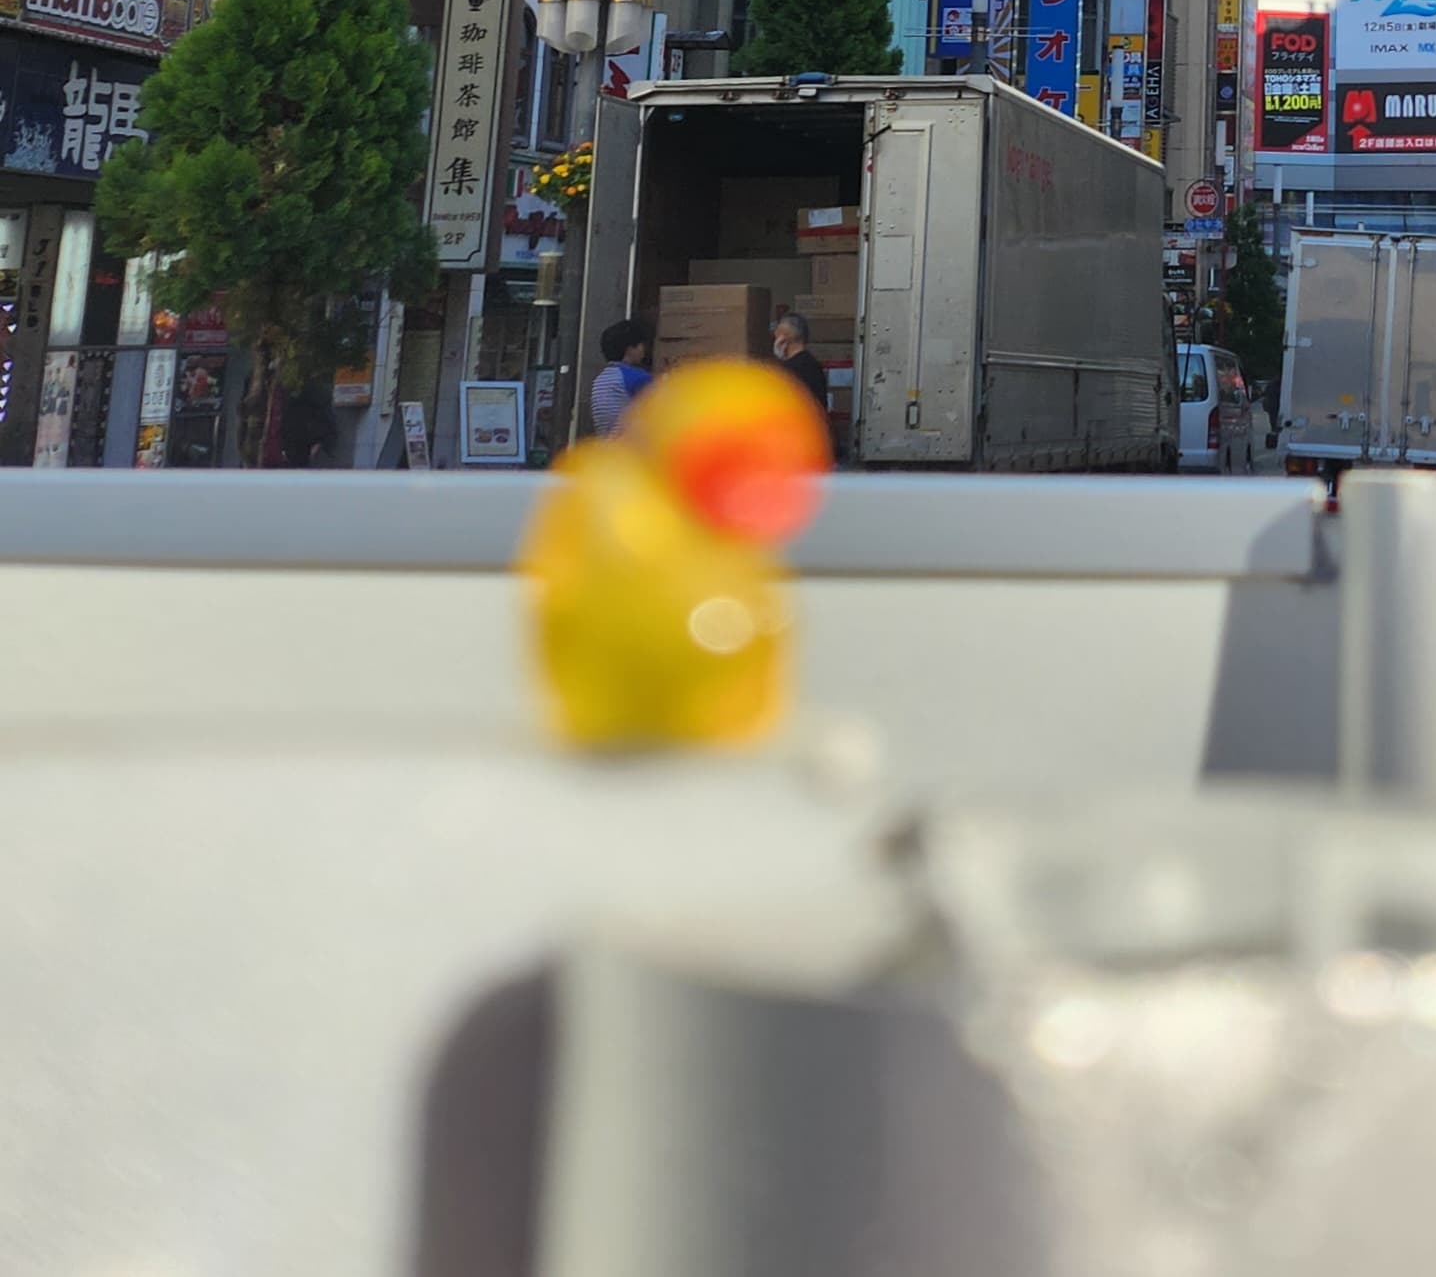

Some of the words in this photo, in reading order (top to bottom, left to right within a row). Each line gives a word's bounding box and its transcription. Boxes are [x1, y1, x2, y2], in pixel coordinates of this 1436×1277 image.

[1270, 32, 1317, 52] FOD
[1370, 43, 1409, 53] IMAX
[440, 157, 481, 197] 集
